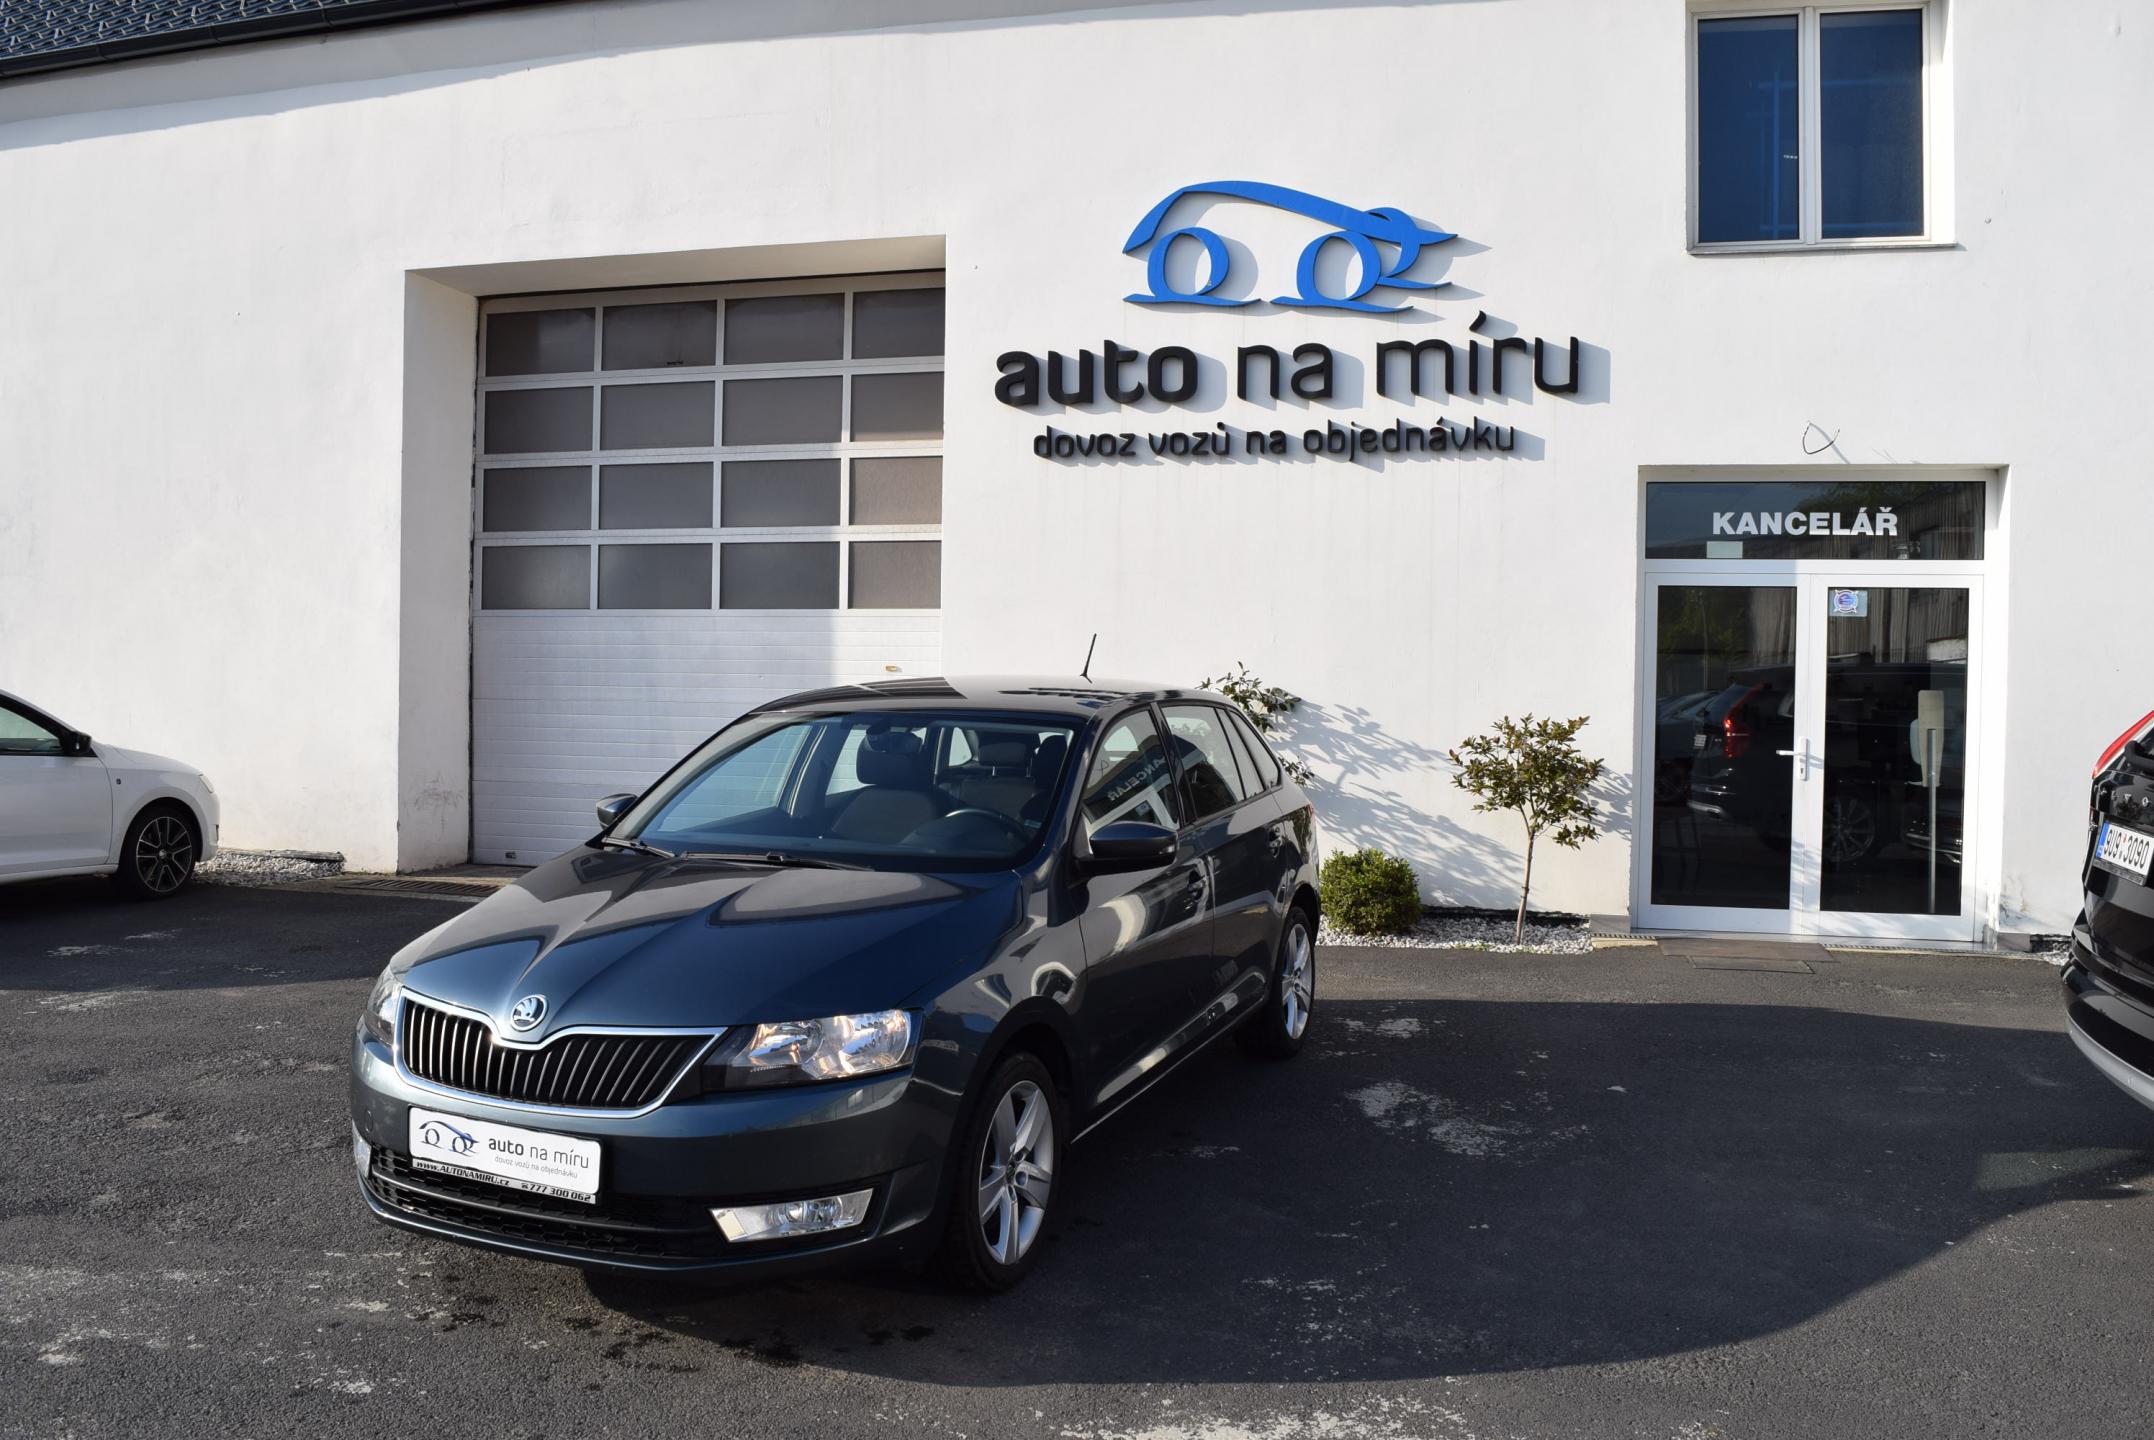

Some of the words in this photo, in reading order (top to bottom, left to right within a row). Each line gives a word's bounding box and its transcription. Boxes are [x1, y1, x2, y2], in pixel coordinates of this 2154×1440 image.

[994, 339, 1199, 407] auto
[1236, 342, 1334, 401] na
[1376, 310, 1580, 397] míru
[1033, 426, 1137, 459] dovoz
[1148, 421, 1231, 457] vozů
[1246, 428, 1288, 455] na
[1302, 416, 1515, 463] objednávku
[1711, 506, 1899, 537] KANCELÁŘ
[2123, 835, 2150, 869] 3090
[488, 1138, 524, 1156] auto
[530, 1146, 548, 1161] na
[553, 1149, 589, 1169] míru
[494, 1154, 514, 1165] dovoz
[540, 1166, 578, 1179] objednávku
[416, 1161, 510, 1186] www.AUTONAMIRU.cz
[530, 1184, 548, 1193] 777
[550, 1187, 569, 1198] 300
[571, 1191, 591, 1202] 062
